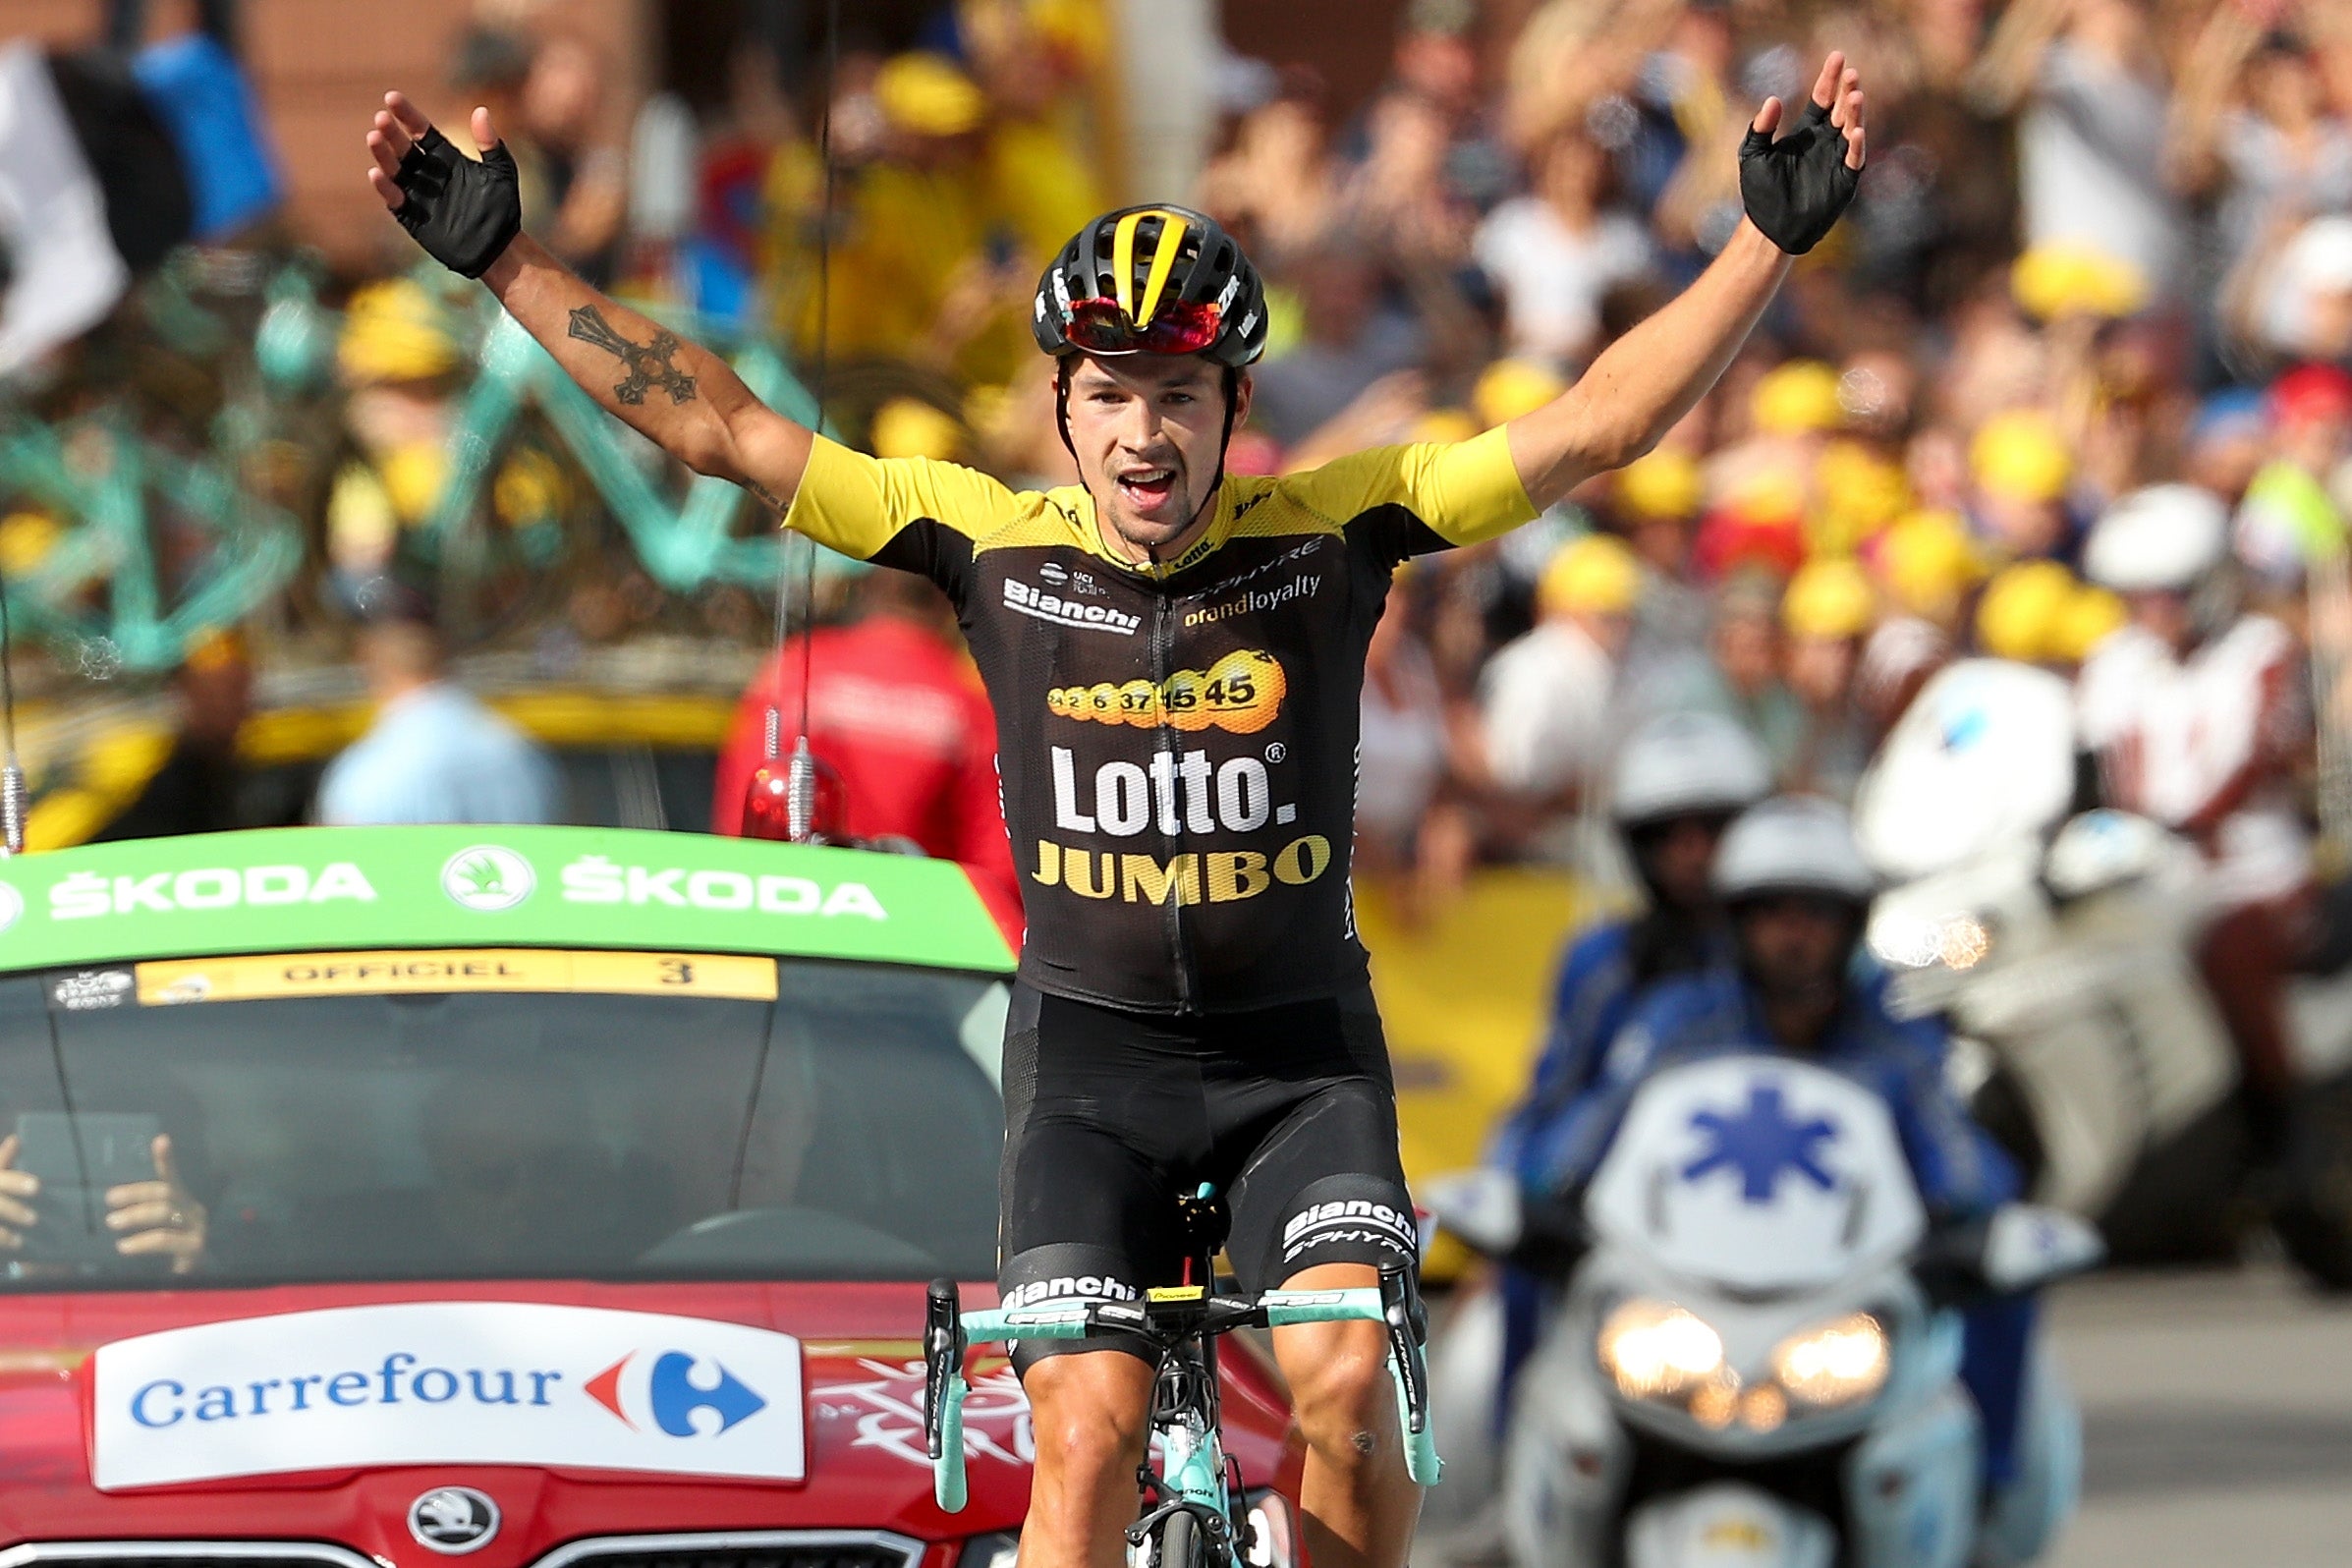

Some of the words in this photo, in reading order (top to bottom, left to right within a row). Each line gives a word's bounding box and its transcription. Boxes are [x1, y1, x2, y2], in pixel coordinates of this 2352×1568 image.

[1073, 571, 1093, 585] UCI
[1003, 578, 1142, 630] Bianchi
[1069, 696, 1080, 707] 2
[1093, 695, 1107, 708] 6
[1120, 694, 1151, 709] 37
[1204, 675, 1256, 706] 45
[49, 863, 377, 921] ŠKODA
[561, 856, 889, 920] ŠKODA
[1032, 835, 1331, 907] JUMBO
[284, 959, 523, 982] OFFICIEL
[658, 957, 693, 984] 3
[1284, 1201, 1417, 1244] Bianchi
[130, 1352, 562, 1428] Carrefour
